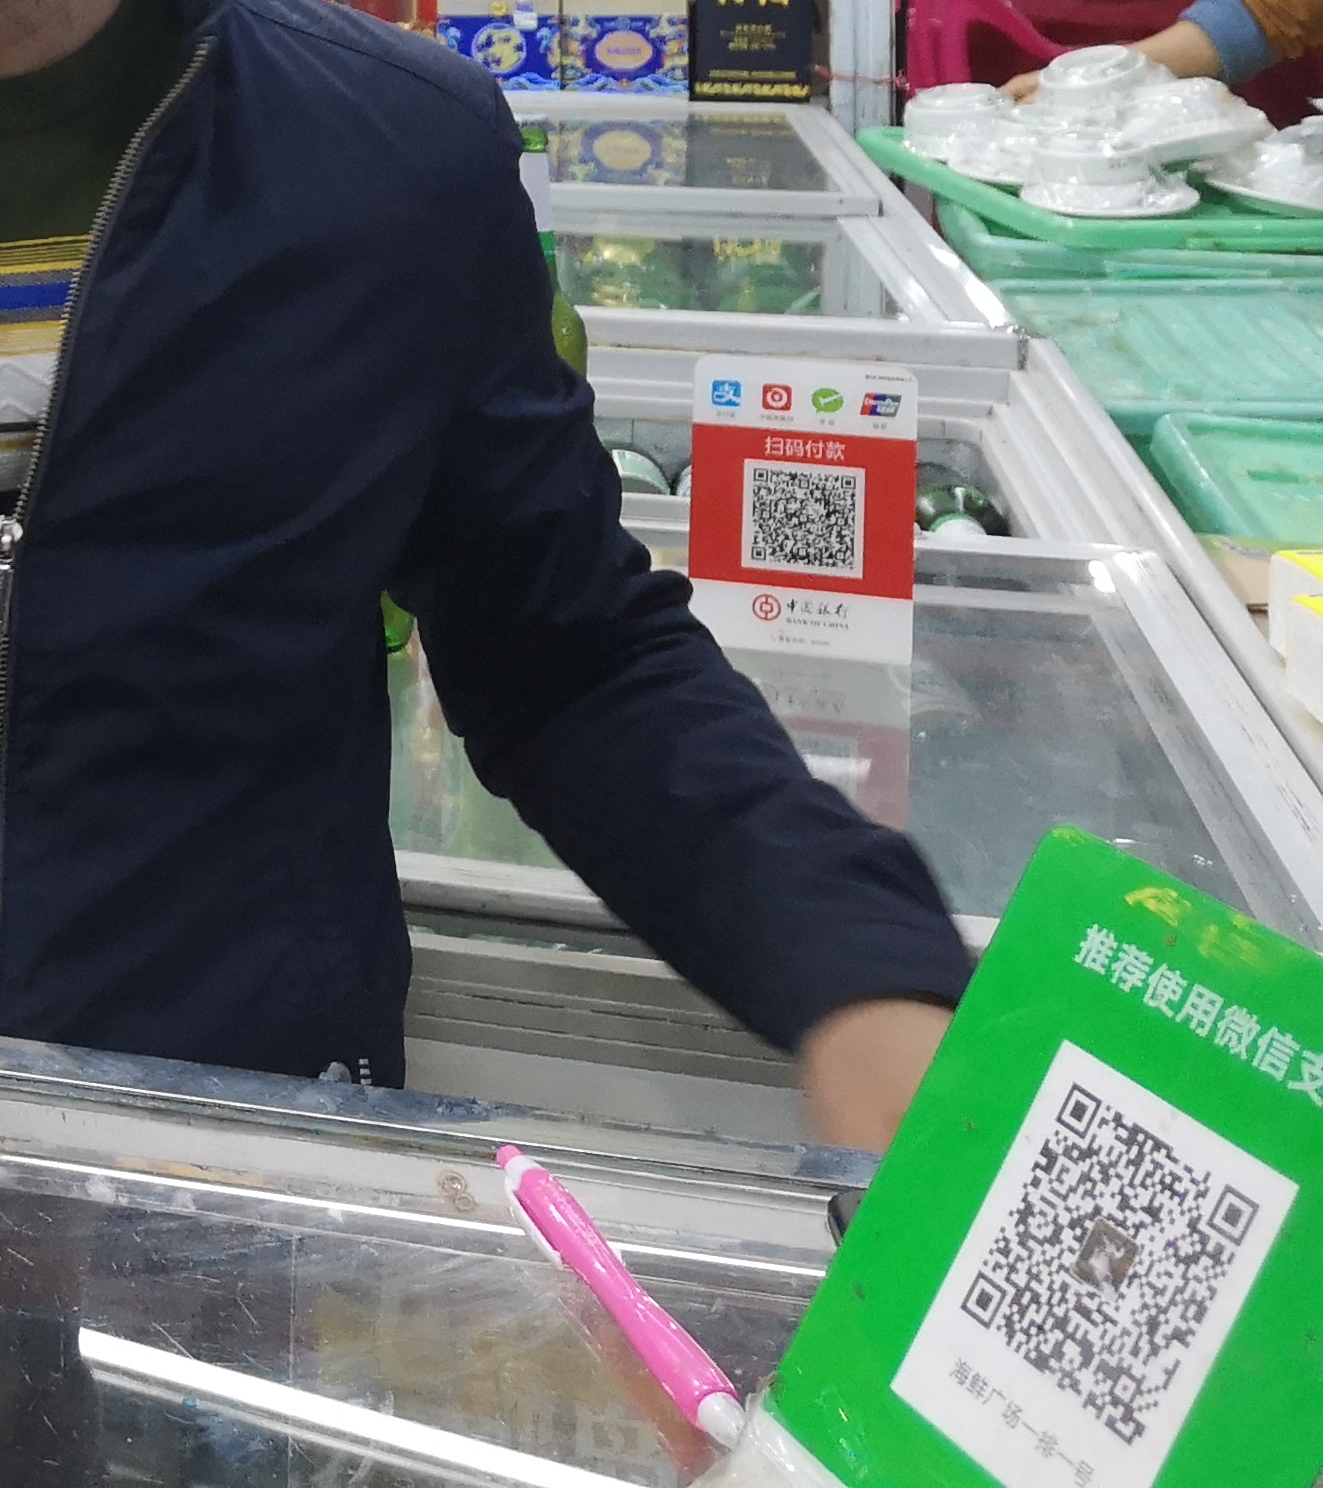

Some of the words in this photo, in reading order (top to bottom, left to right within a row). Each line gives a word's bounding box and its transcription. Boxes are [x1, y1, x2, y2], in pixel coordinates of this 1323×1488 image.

[764, 435, 846, 461] 扫码付款
[1071, 922, 1323, 1108] 推荐使用微信支
